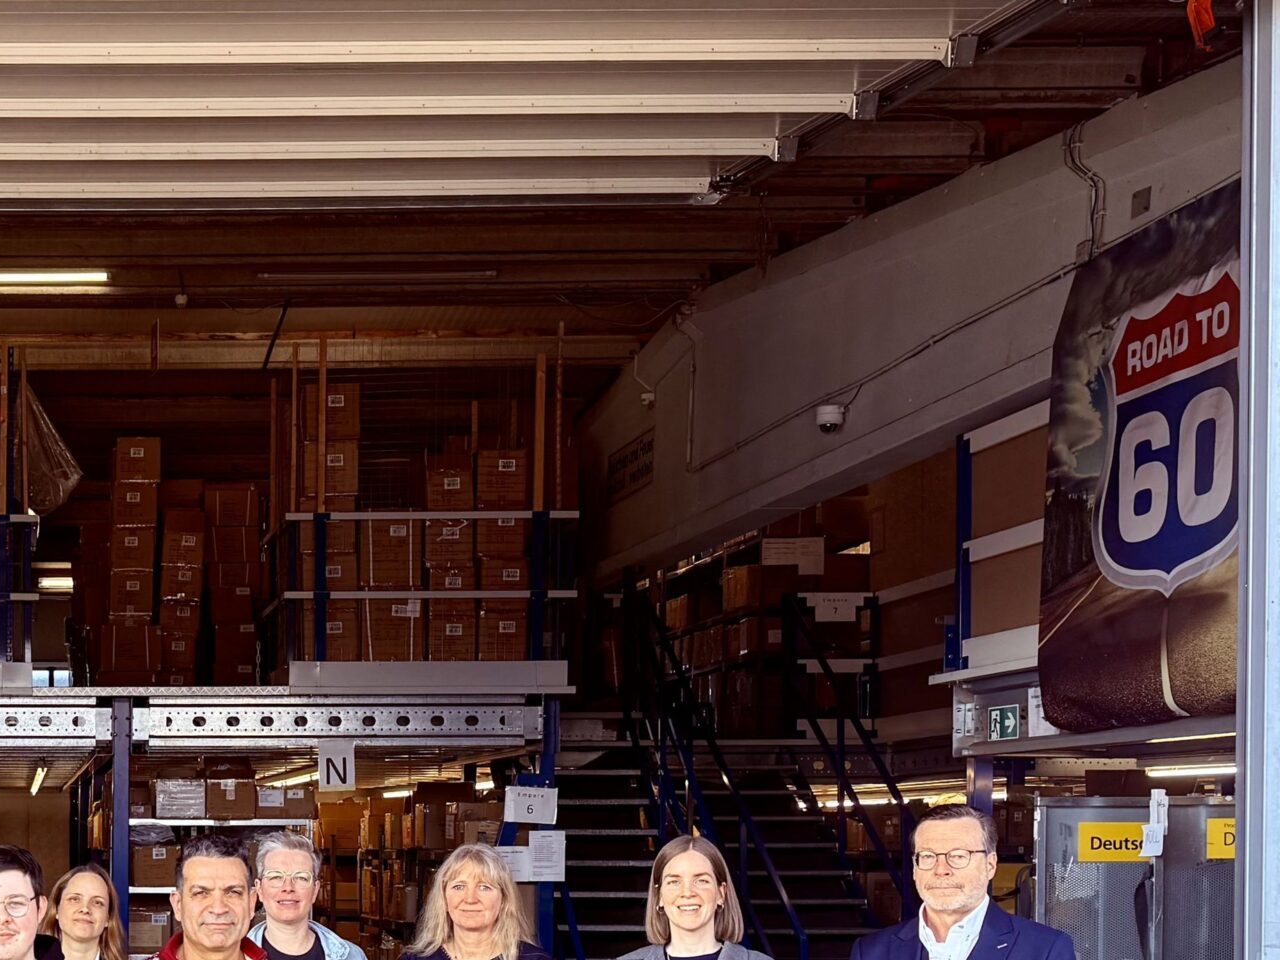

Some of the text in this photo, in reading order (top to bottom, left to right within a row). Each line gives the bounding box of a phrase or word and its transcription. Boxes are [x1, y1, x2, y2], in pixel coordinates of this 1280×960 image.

[1126, 301, 1230, 377] ROAD TO
[1118, 386, 1235, 543] 60
[832, 607, 838, 615] 7
[326, 757, 347, 785] N
[526, 804, 534, 815] 6
